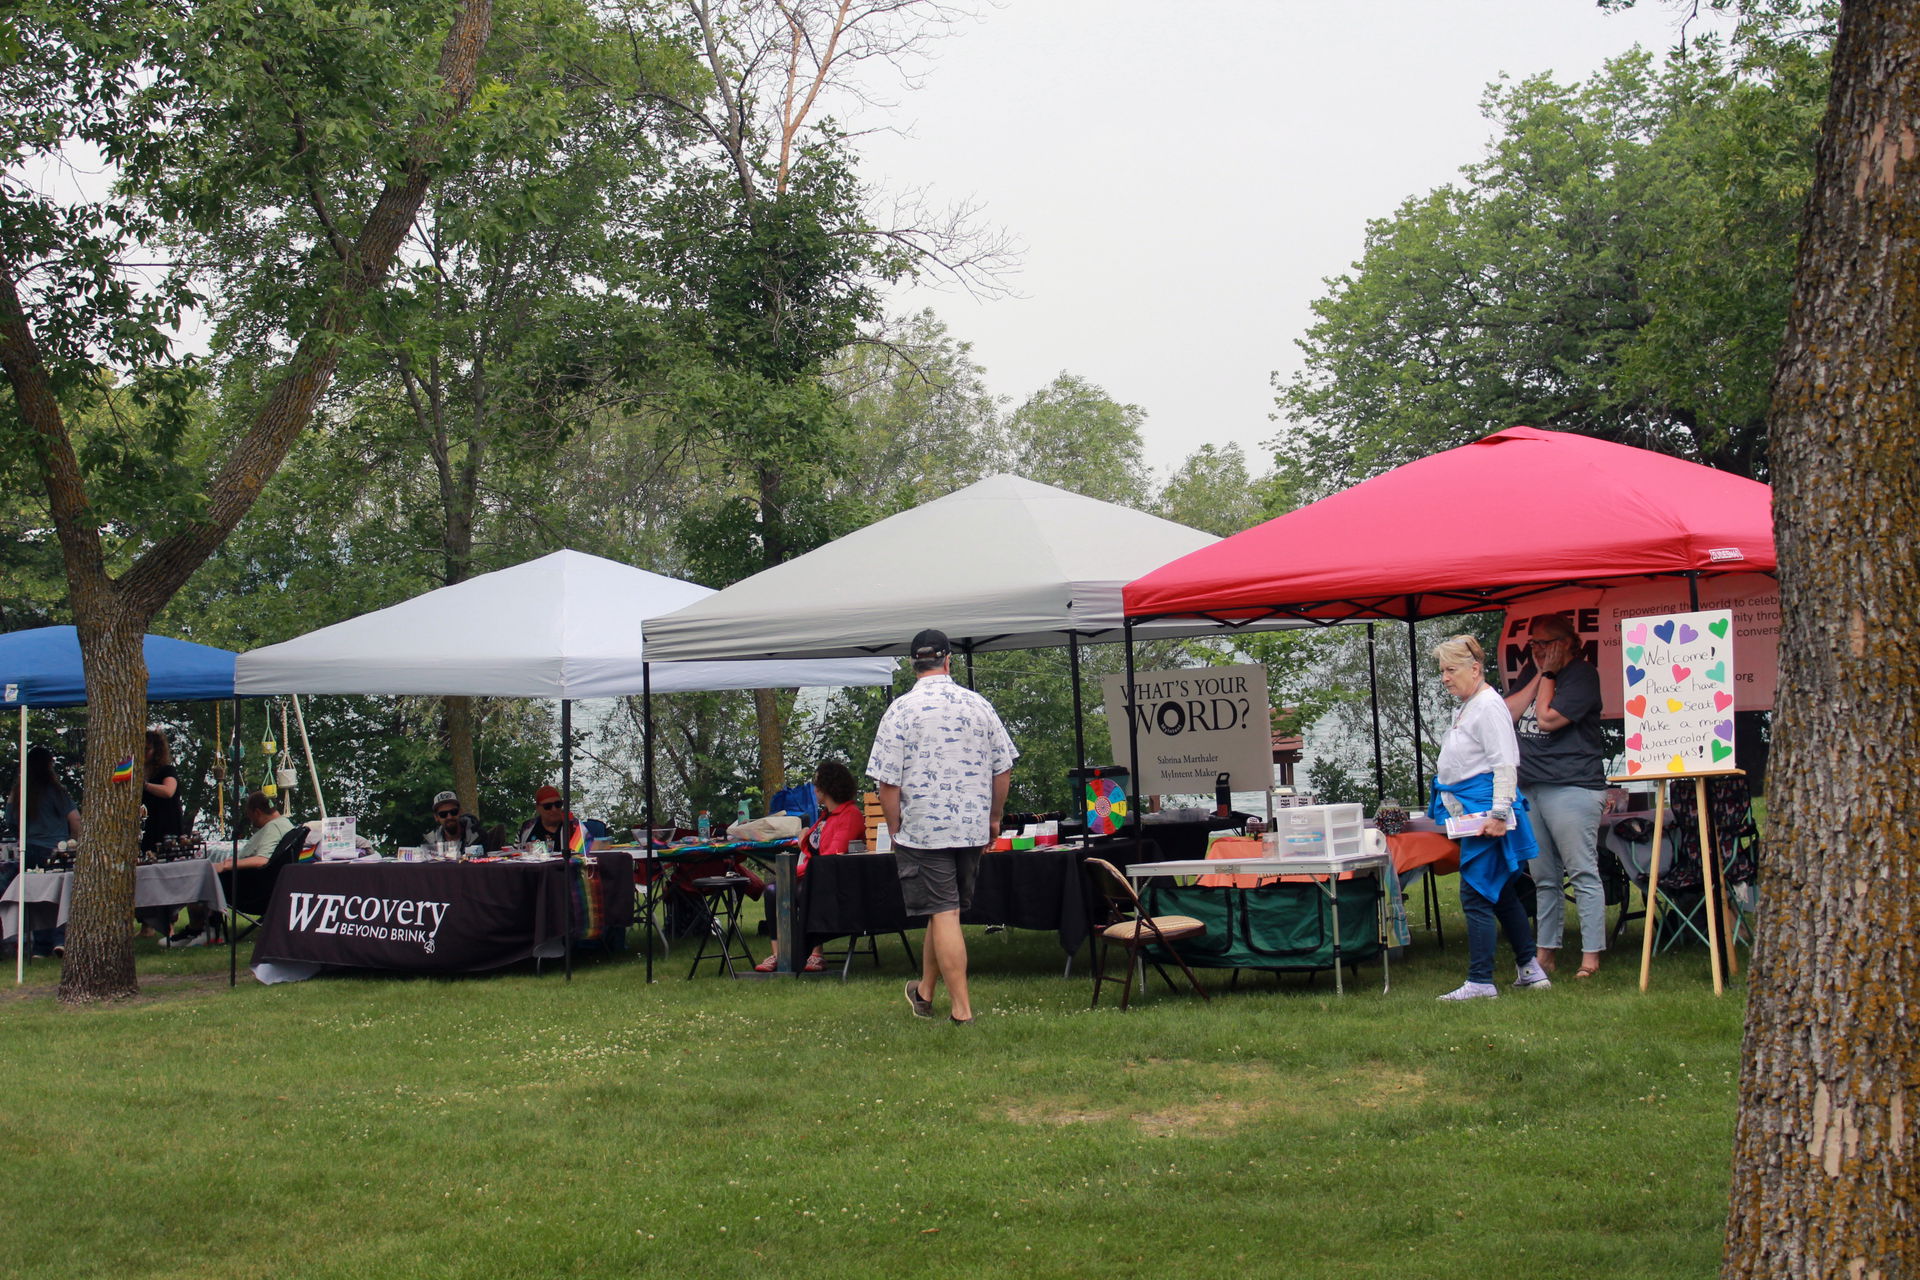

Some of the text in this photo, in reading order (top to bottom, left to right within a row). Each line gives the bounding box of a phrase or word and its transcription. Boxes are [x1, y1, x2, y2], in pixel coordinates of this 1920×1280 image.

[1612, 603, 1676, 618] Empowering
[1700, 599, 1731, 609] world
[1734, 599, 1745, 607] to
[1643, 645, 1715, 666] Welcome!
[1194, 676, 1249, 695] YOUR
[1645, 678, 1718, 694] Please have
[1121, 698, 1250, 736] WORD?
[1651, 705, 1664, 714] a
[1680, 720, 1691, 728] a
[1157, 752, 1219, 765] Sabrina Marthaler
[1160, 768, 1218, 781] MyIntent Maker
[288, 892, 451, 938] WEcovery
[339, 922, 426, 943] BEYOND BRINK
